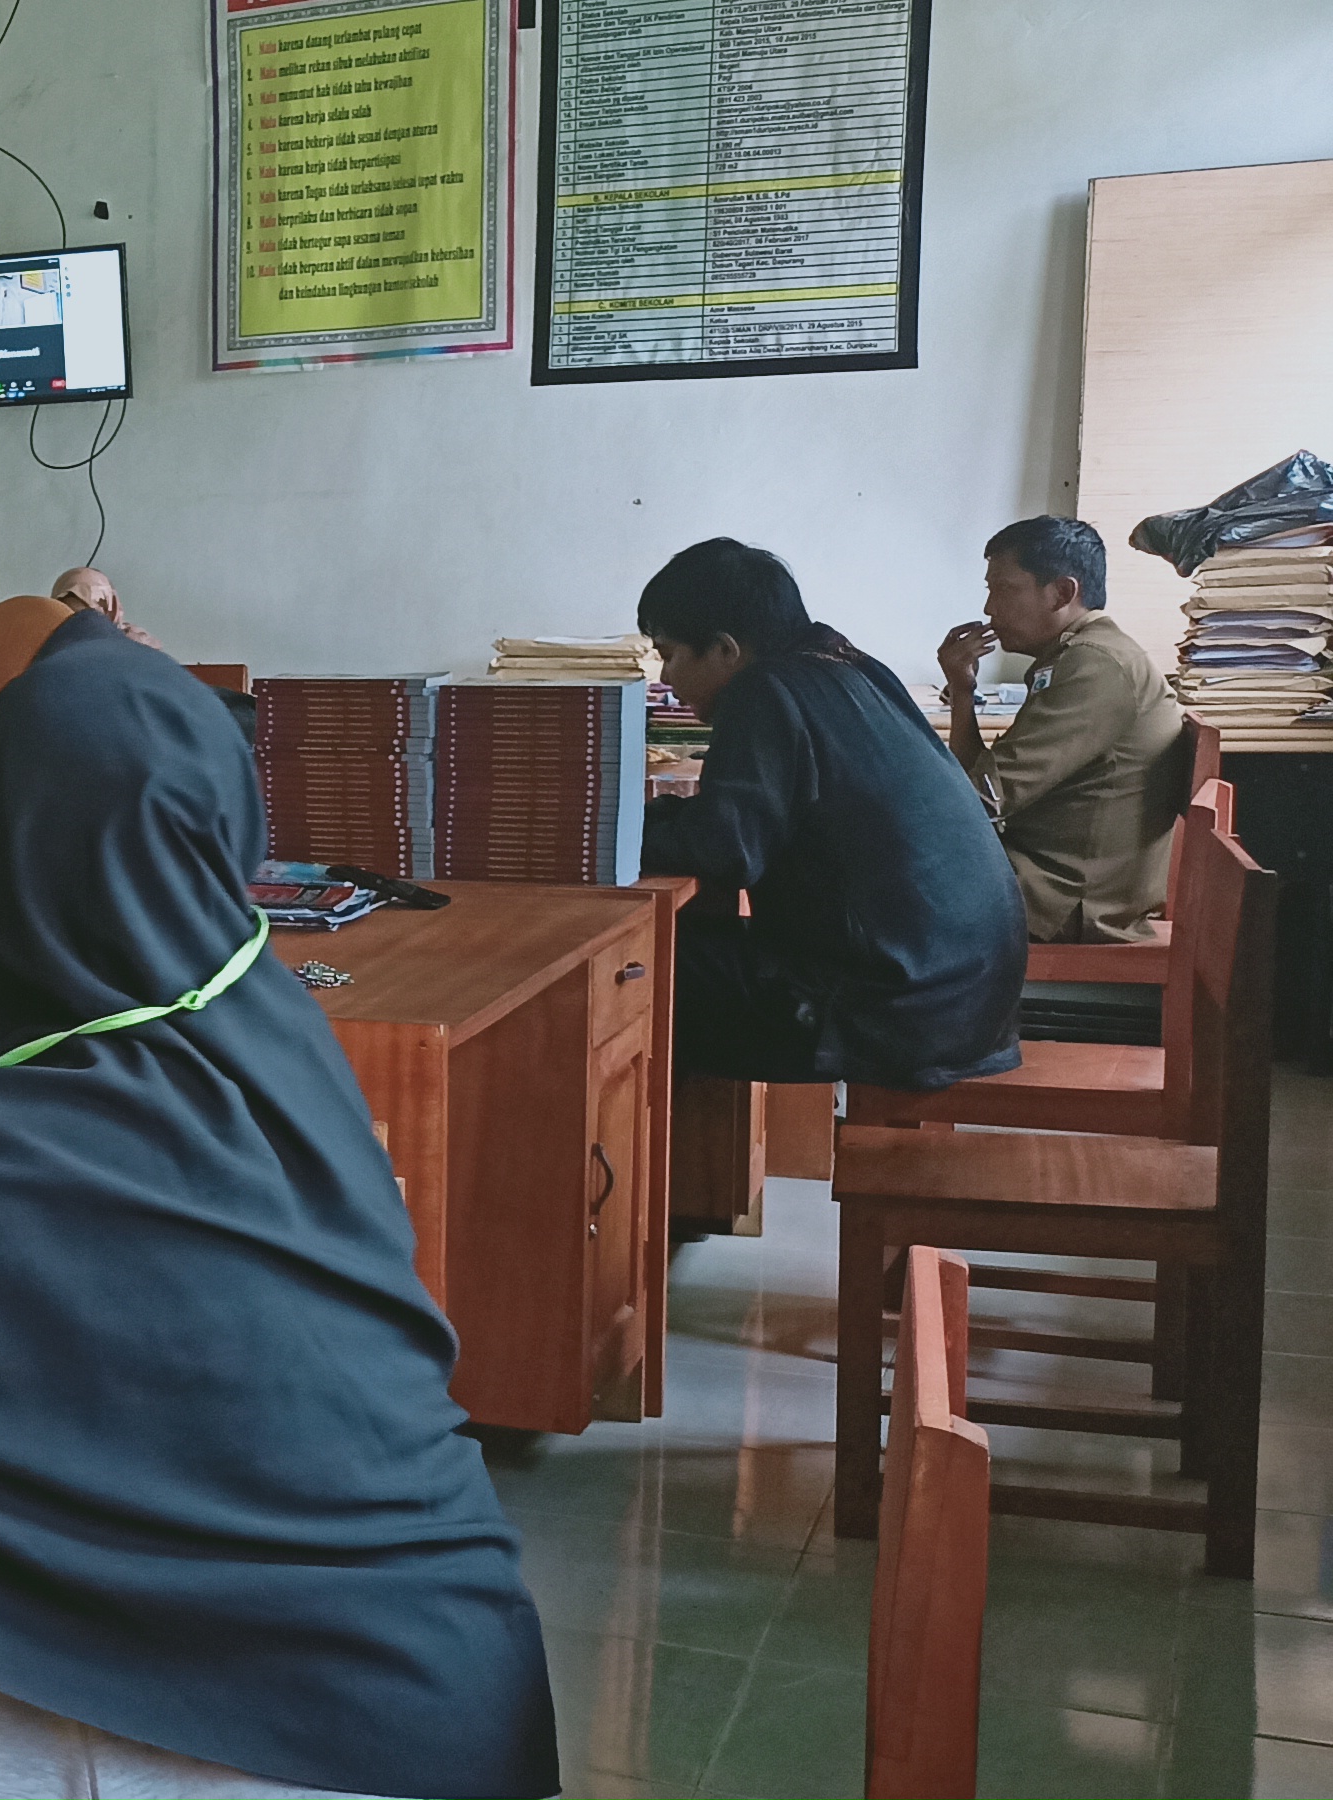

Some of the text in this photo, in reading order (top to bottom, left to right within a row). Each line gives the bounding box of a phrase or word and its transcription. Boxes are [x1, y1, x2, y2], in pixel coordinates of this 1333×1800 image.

[278, 39, 303, 51] karena
[305, 35, 332, 48] datang
[333, 29, 370, 44] terlambat
[372, 25, 399, 42] pulang
[278, 114, 303, 126] karena
[305, 110, 325, 124] kerja
[277, 139, 303, 151] karena
[305, 135, 333, 148] bekerja
[335, 131, 355, 145] tidak
[277, 164, 303, 176] karena
[305, 160, 325, 174] kerja
[277, 189, 303, 201] karena
[304, 185, 326, 200] Tugas
[319, 210, 334, 222] dan
[277, 237, 297, 251] tidak
[277, 262, 297, 275] tidak
[299, 261, 334, 275] berperan
[430, 247, 474, 261] kebersihan
[278, 287, 293, 300] dan
[295, 285, 336, 298] keindahan
